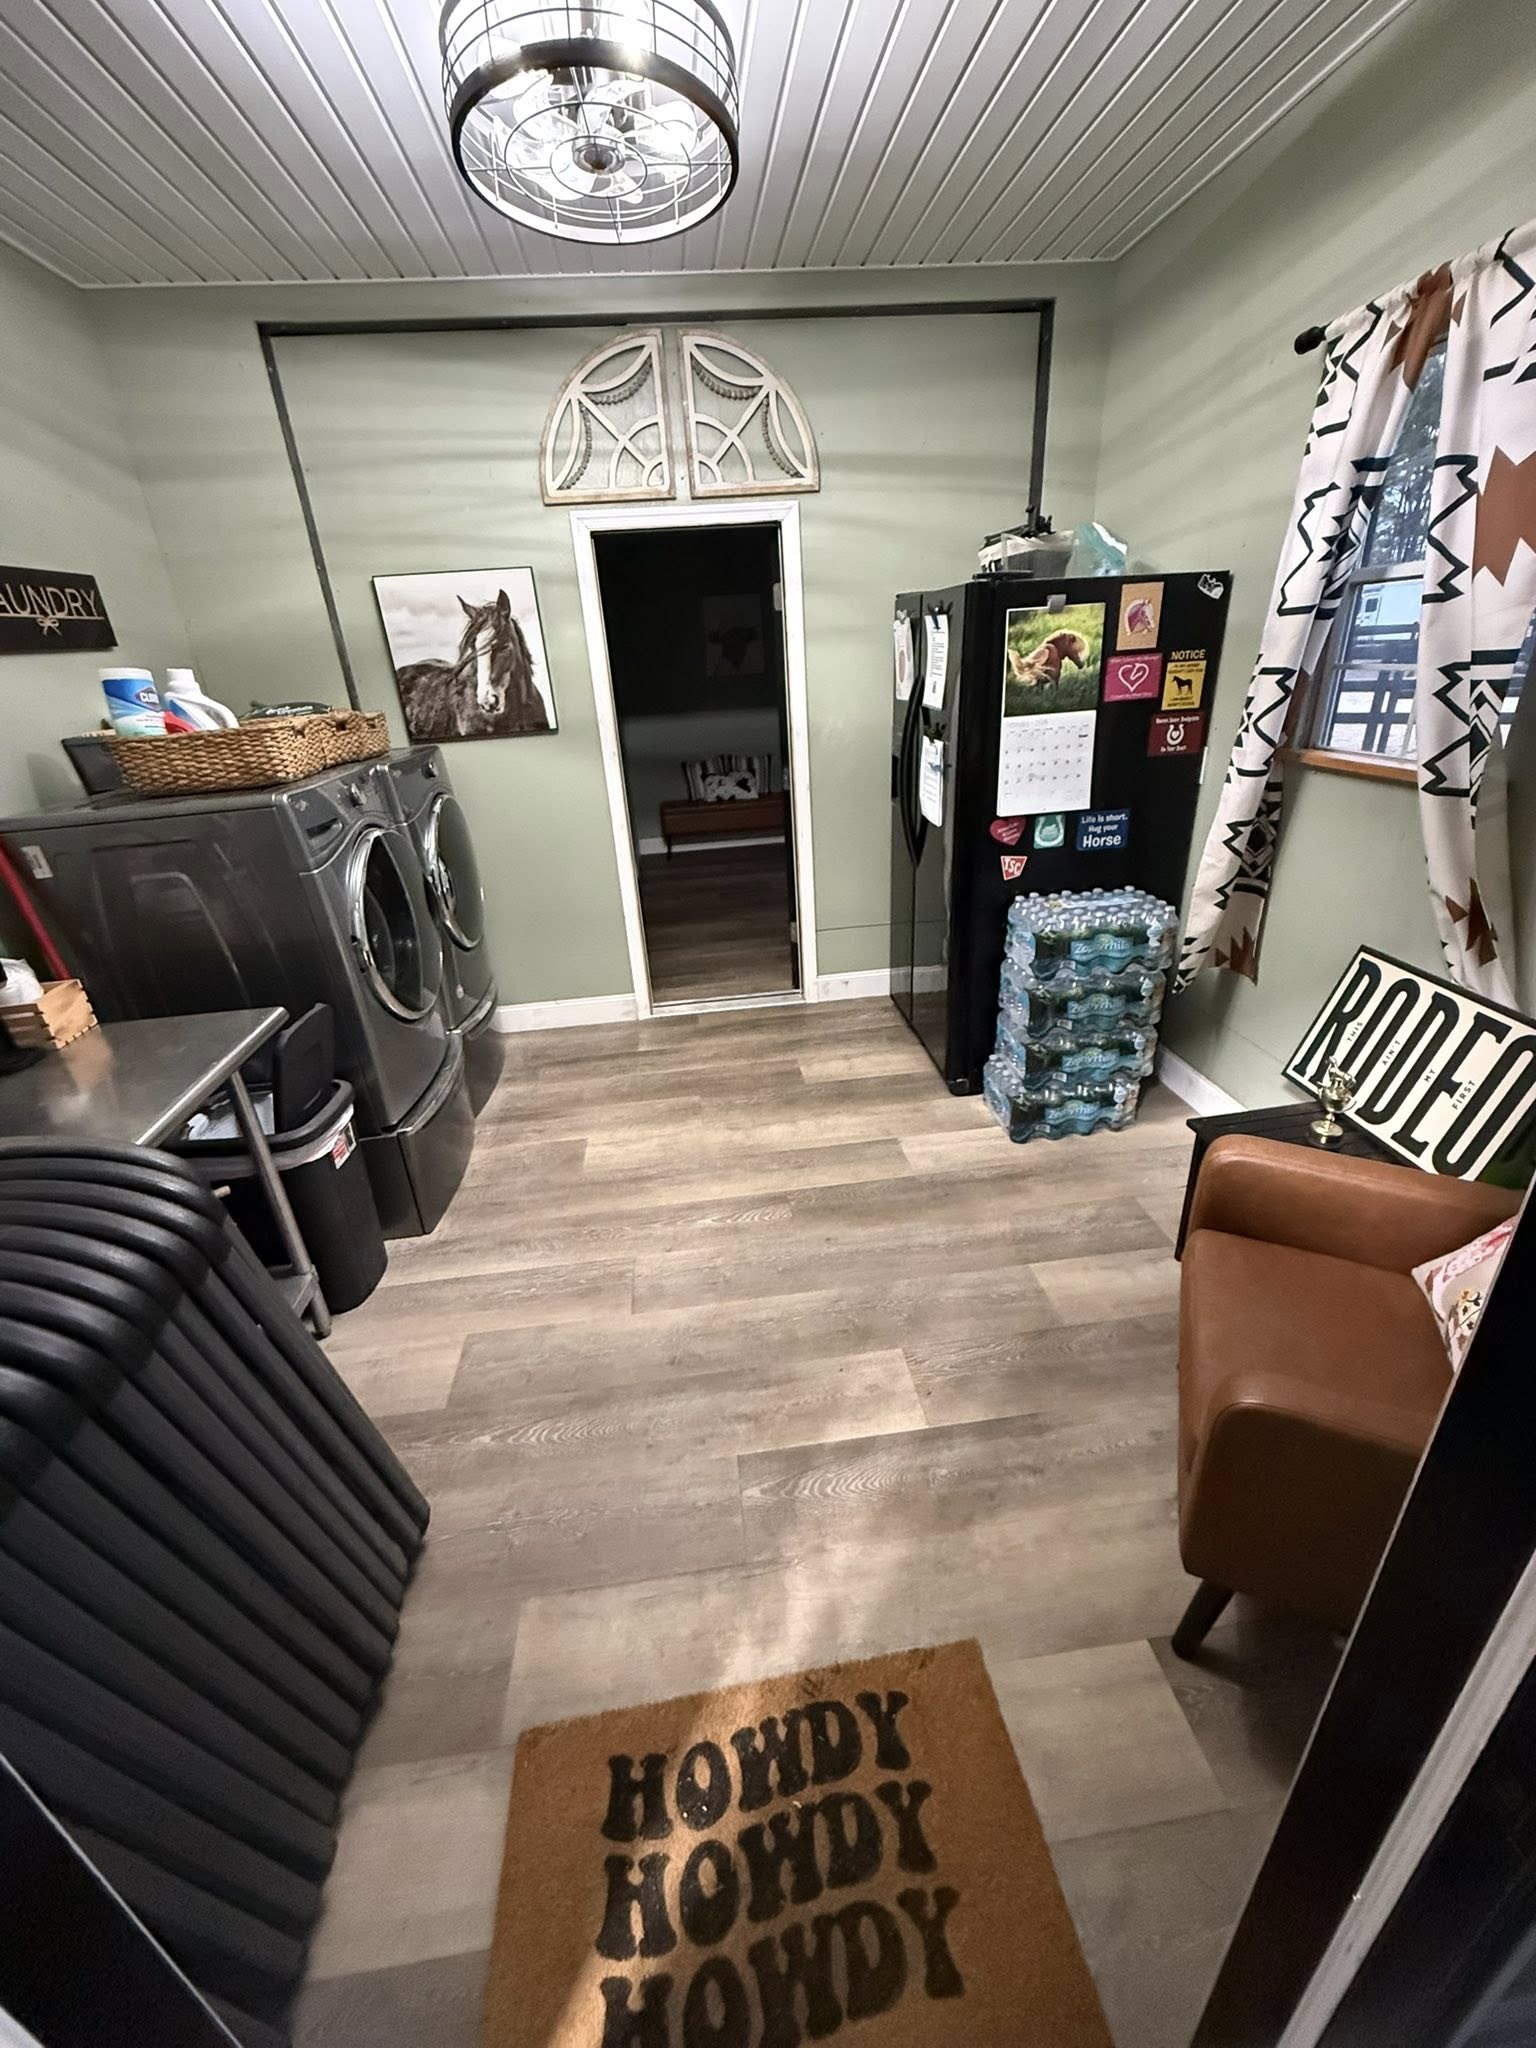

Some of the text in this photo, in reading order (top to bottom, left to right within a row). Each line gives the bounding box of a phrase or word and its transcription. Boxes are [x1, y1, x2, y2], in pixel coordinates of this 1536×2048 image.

[0, 583, 97, 617] AUNDRY
[1171, 649, 1206, 660] NOTICE
[1081, 815, 1096, 824] Life
[1097, 814, 1104, 823] is
[1083, 834, 1121, 848] Horse
[1004, 857, 1021, 876] TSC
[1292, 958, 1536, 1176] RODEO
[1347, 1021, 1476, 1110] THIS AIN'T MY FIRST
[601, 1691, 911, 1842] HOWDY
[597, 1781, 936, 1960] HOWDY
[600, 1887, 965, 2048] HOWDY
